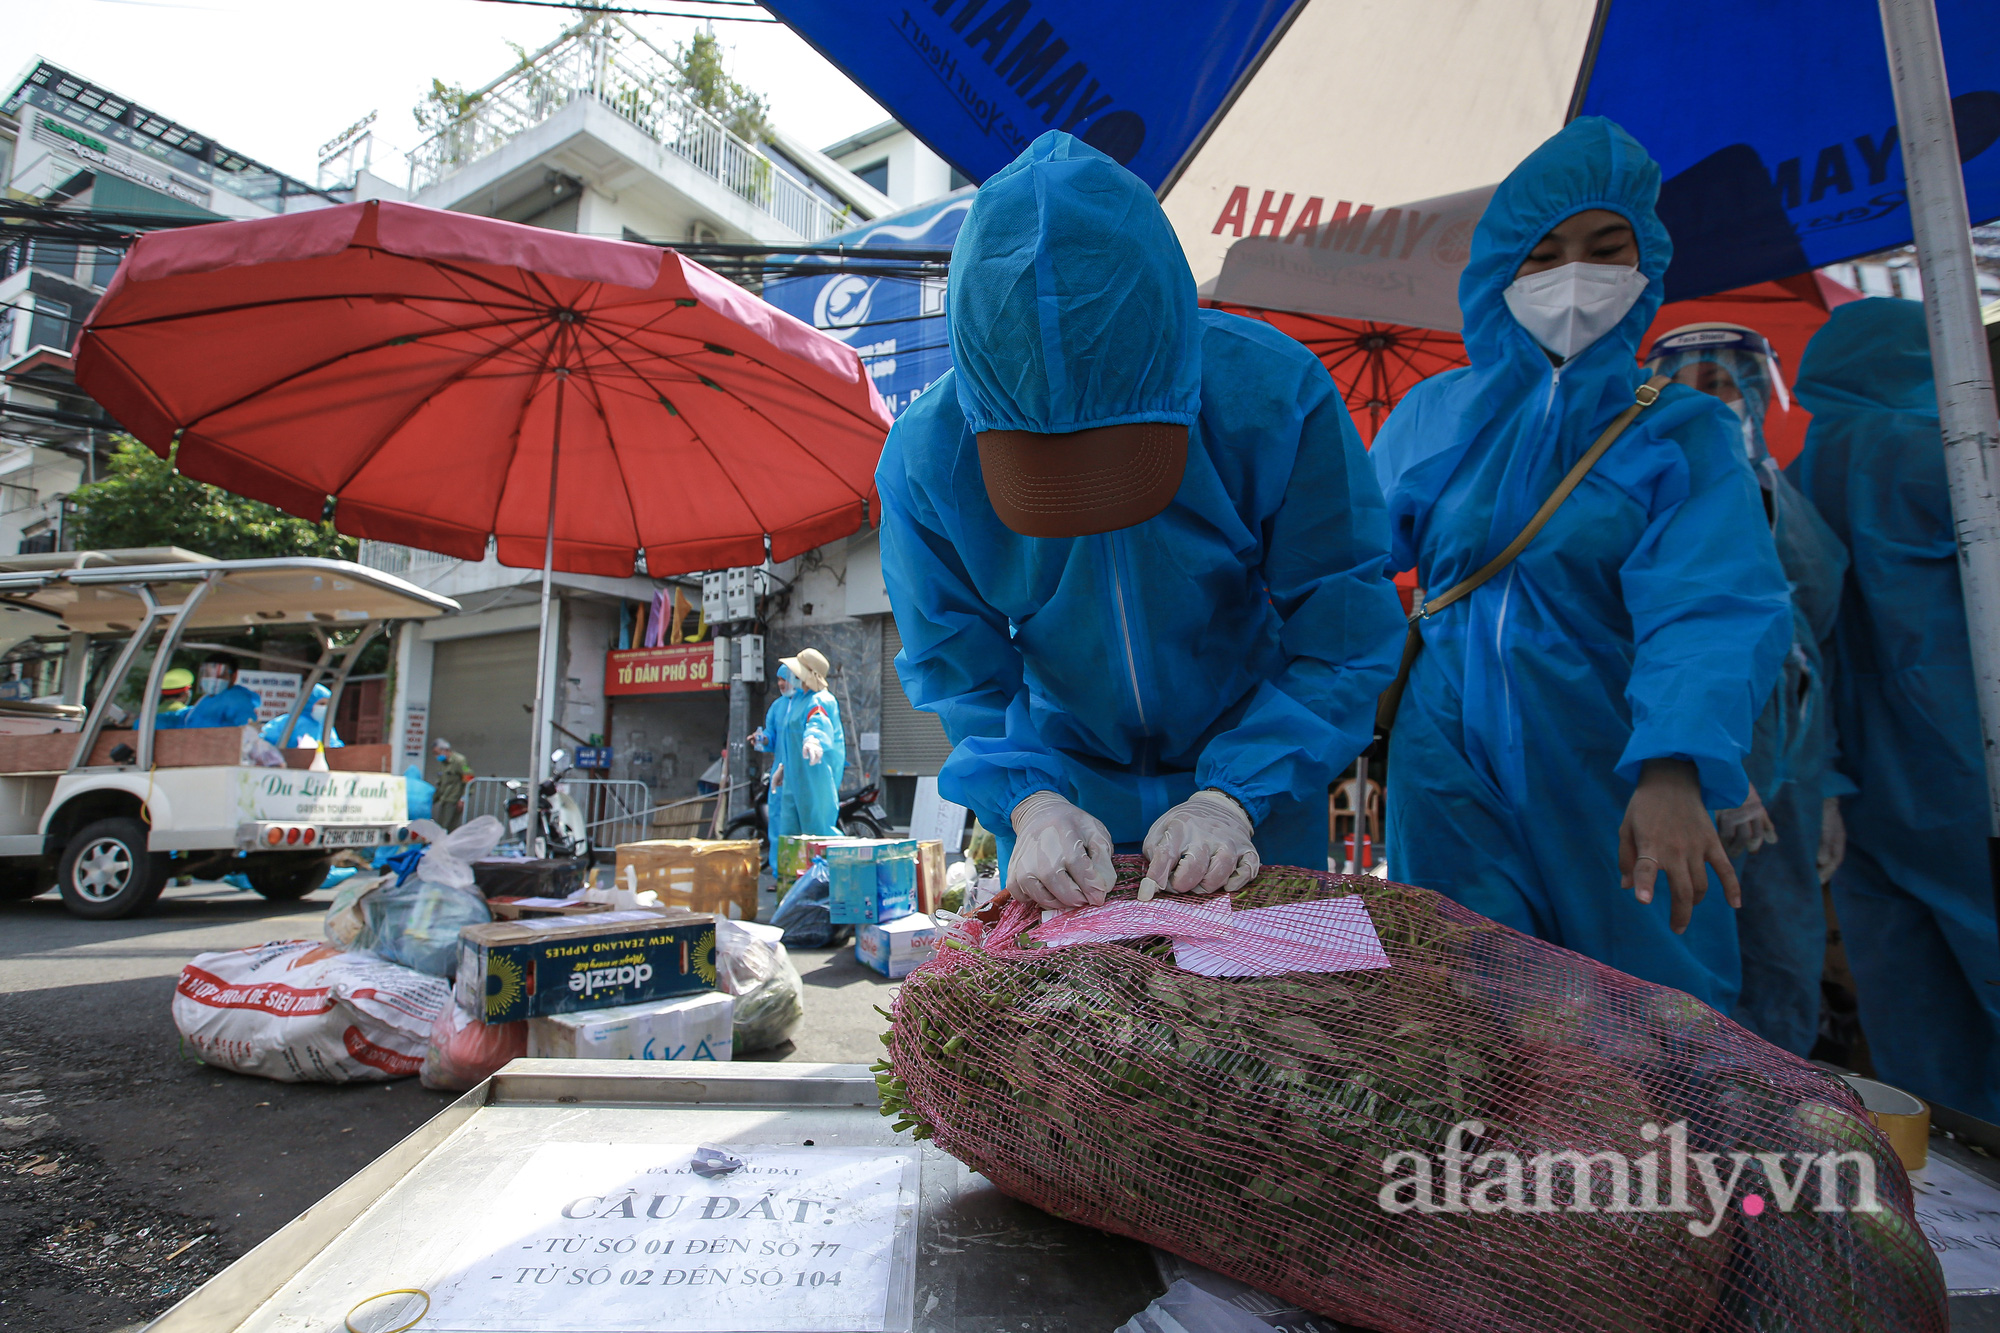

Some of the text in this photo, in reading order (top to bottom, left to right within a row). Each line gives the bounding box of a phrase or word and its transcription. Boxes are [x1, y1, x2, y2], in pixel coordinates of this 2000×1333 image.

[635, 663, 659, 683] DÂN
[662, 658, 688, 682] PHỐ
[690, 656, 708, 680] SỐ
[261, 774, 293, 796] Du
[296, 804, 363, 815] GREEN TOURISM
[545, 935, 674, 959] NEW ZEALAND APPLES
[568, 963, 653, 996] dazzle
[560, 1188, 837, 1226] CẦU ĐẤT:
[544, 1234, 592, 1254] TỪ
[593, 1233, 637, 1254] SỐ
[643, 1239, 675, 1255] 01
[684, 1234, 753, 1255] ĐẾN
[759, 1236, 801, 1257] SỐ
[810, 1242, 842, 1258] 77
[515, 1264, 567, 1284] TỪ
[567, 1263, 612, 1285] SỐ
[619, 1270, 652, 1285] 02
[662, 1266, 734, 1286] ĐẾN
[740, 1266, 785, 1287] SỐ
[794, 1269, 843, 1287] 104
